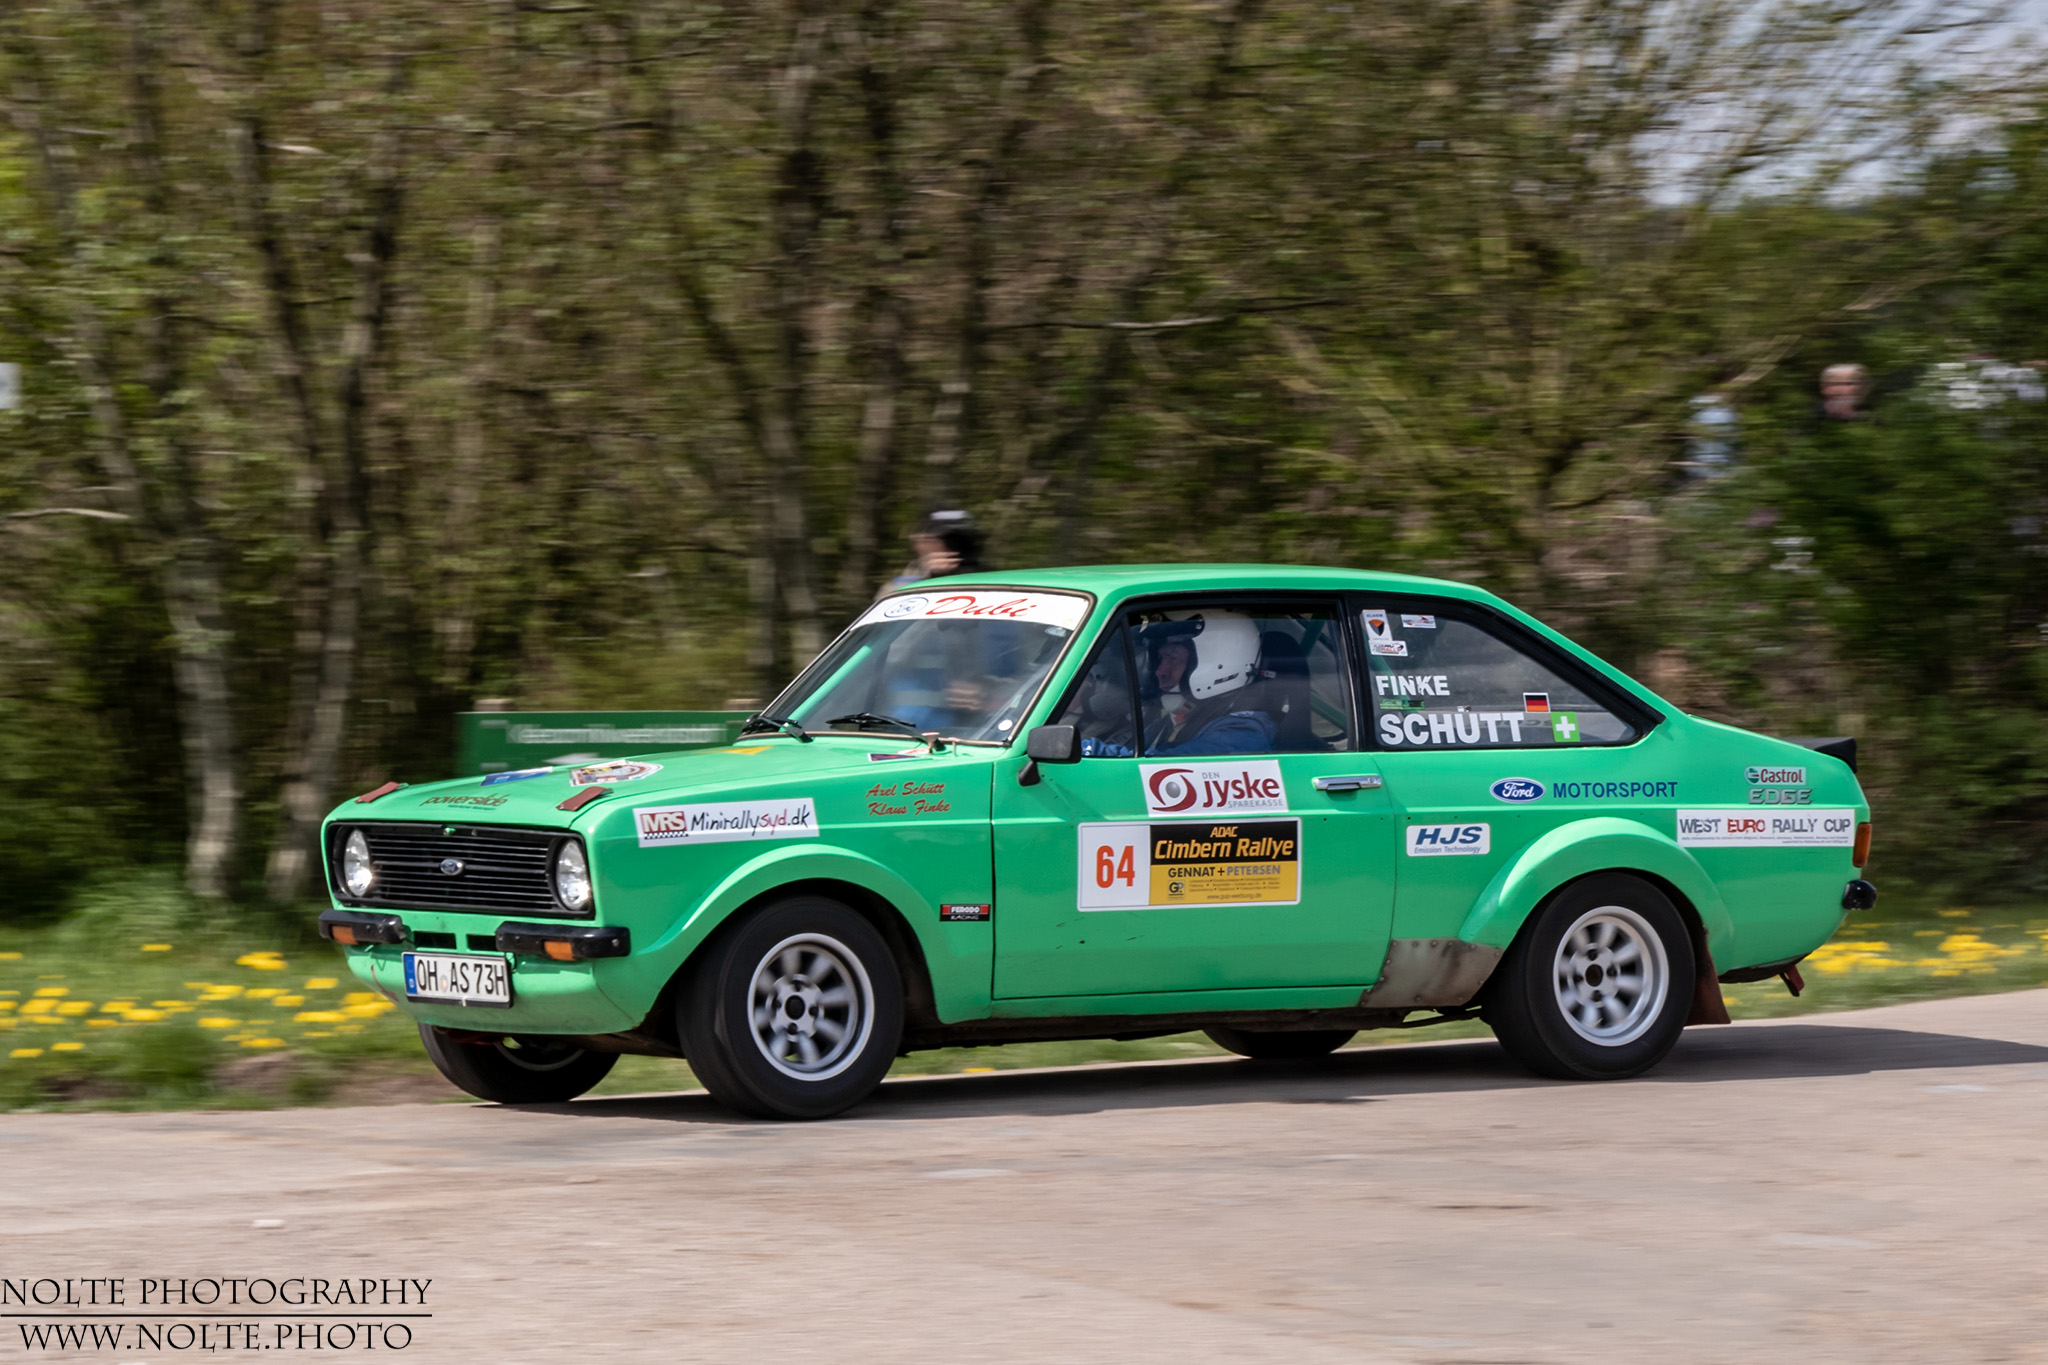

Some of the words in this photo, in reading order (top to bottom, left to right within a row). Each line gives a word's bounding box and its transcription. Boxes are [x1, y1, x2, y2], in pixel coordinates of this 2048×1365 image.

[925, 595, 1037, 618] Dubi
[1375, 675, 1450, 696] FINKE
[1380, 706, 1525, 745] SCHÜTT
[1760, 768, 1803, 783] Castrol
[865, 783, 898, 798] Axel
[901, 781, 945, 796] Schütt
[1202, 771, 1280, 808] jyske
[1501, 781, 1535, 798] Ford
[1553, 781, 1678, 798] MOTORSPORT
[1749, 788, 1814, 804] EDGE
[868, 801, 907, 816] Klaus
[913, 799, 951, 816] Finke
[1227, 799, 1284, 808] SPAREKASSE
[641, 812, 686, 833] MRS
[690, 804, 810, 836] Minirallysyd.dk
[1679, 818, 1721, 834] WEST
[1727, 818, 1766, 834] EURO
[1772, 817, 1818, 834] RALLY
[1824, 818, 1851, 834] CUP
[1209, 826, 1239, 838] ADAC
[1415, 826, 1483, 845] HJS
[1154, 839, 1232, 860] Cimbern
[1236, 837, 1294, 860] Rallye
[1414, 846, 1442, 854] Emission
[1444, 845, 1481, 854] Technology
[1096, 845, 1135, 888] 64
[1168, 867, 1216, 878] GENNAT
[1227, 865, 1281, 876] PETERSEN
[416, 959, 439, 992] OH
[449, 962, 469, 994] AS
[473, 963, 508, 997] 73H
